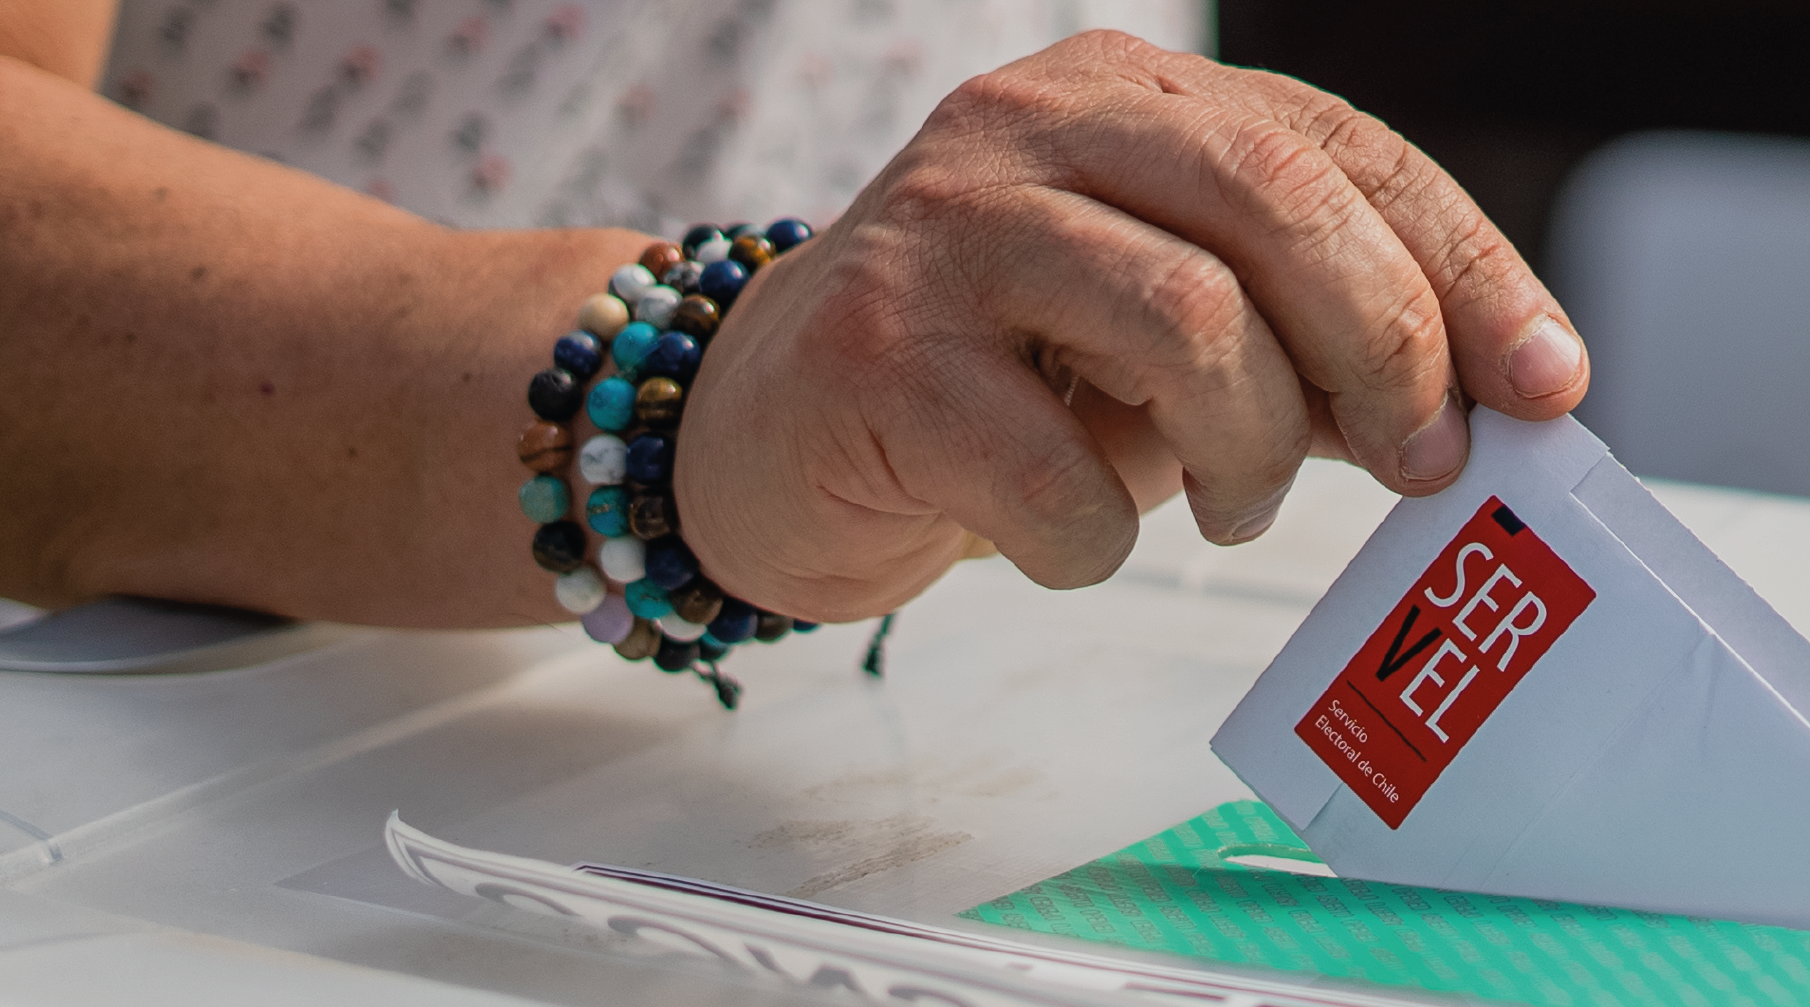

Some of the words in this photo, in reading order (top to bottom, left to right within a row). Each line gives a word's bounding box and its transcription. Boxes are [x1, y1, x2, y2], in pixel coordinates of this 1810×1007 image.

[1424, 542, 1547, 672] SER
[1328, 699, 1368, 743] Servicio
[1376, 604, 1480, 743] VEL
[1315, 715, 1361, 763] Electoral
[1357, 760, 1373, 777] de
[1372, 772, 1399, 803] Chile
